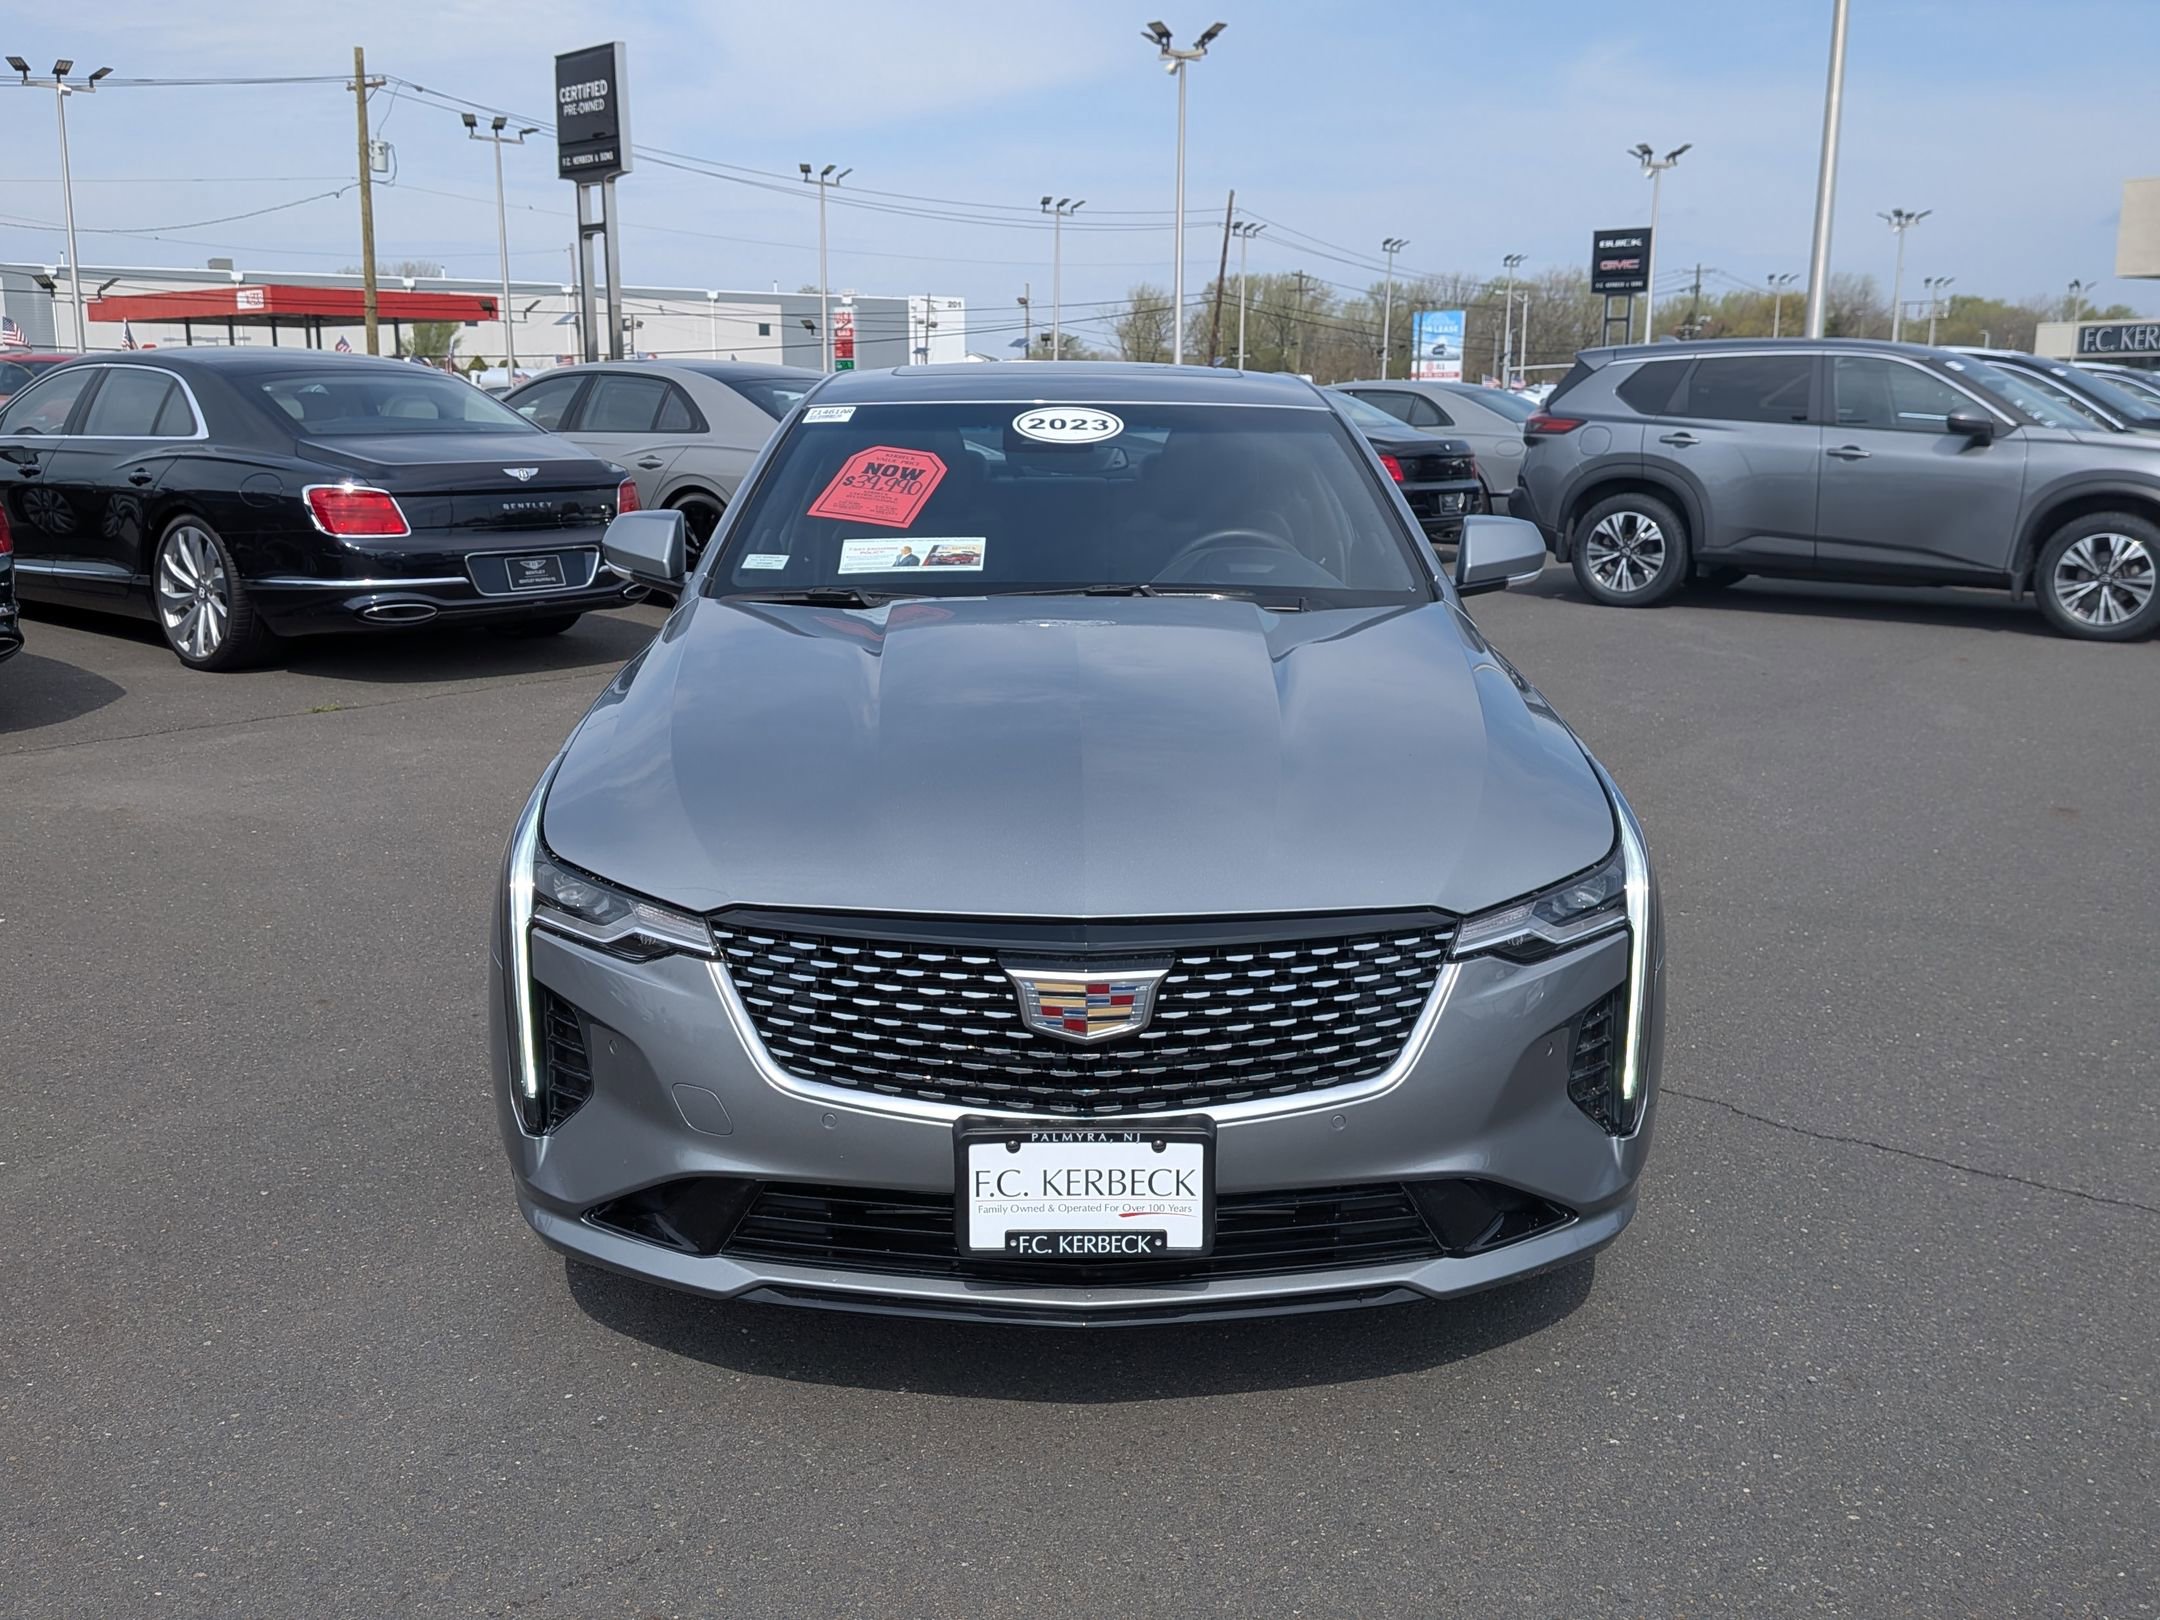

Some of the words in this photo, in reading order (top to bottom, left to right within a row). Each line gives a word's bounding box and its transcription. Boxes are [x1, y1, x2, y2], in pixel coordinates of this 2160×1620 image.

[559, 79, 608, 103] CERTIFIED
[563, 98, 605, 116] PRE-OWNED
[1599, 238, 1642, 248] BUICK
[1600, 259, 1640, 270] GMC
[2083, 327, 2115, 352] F.C.
[2120, 325, 2160, 351] KER
[1027, 418, 1109, 430] 2023
[861, 462, 926, 481] NOW
[503, 502, 552, 510] BENTLEY
[1031, 1132, 1114, 1143] PALMYRA,
[1123, 1132, 1141, 1142] NJ
[975, 1169, 1029, 1198] F.C.
[1043, 1169, 1196, 1197] KERBECK
[978, 1204, 1008, 1214] Family
[1010, 1203, 1045, 1213] Owned
[1047, 1204, 1055, 1213] &
[1058, 1203, 1102, 1214] Operated
[1104, 1203, 1119, 1213] For
[1122, 1203, 1146, 1213] Over
[1148, 1203, 1166, 1213] 100
[1168, 1204, 1192, 1213] Years
[1018, 1236, 1052, 1253] F.C.
[1059, 1235, 1151, 1253] KERBECK
